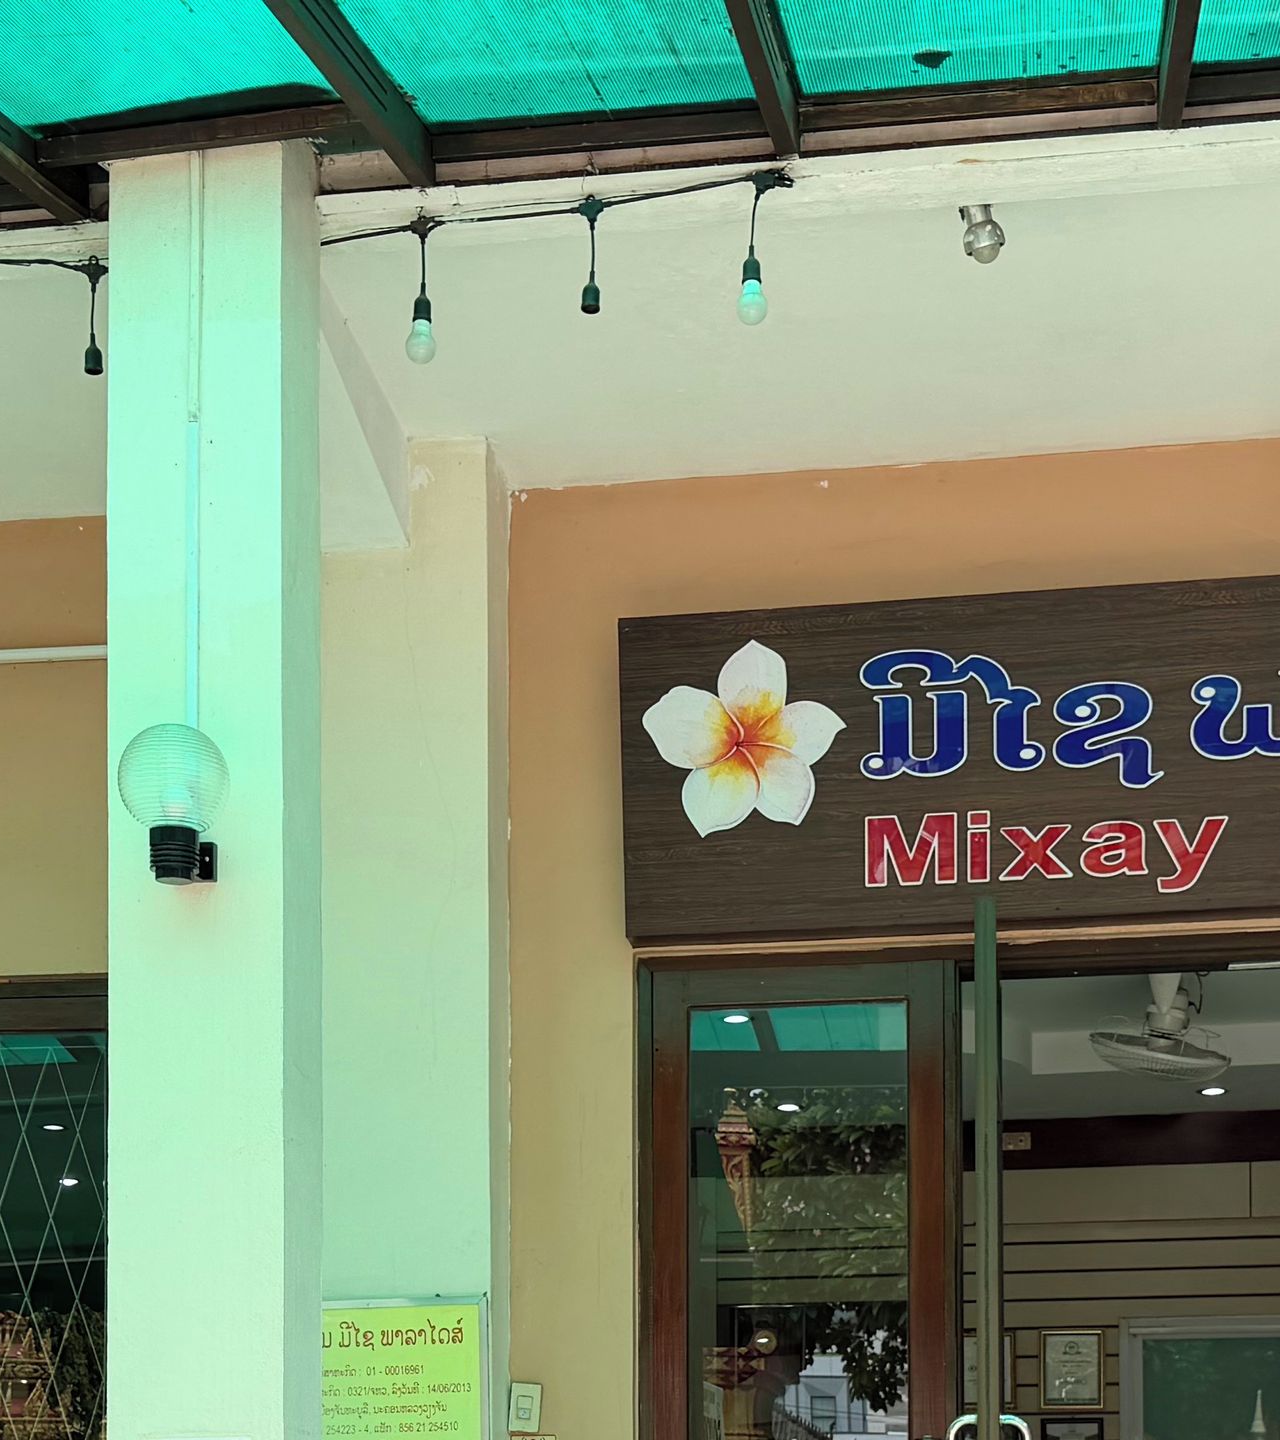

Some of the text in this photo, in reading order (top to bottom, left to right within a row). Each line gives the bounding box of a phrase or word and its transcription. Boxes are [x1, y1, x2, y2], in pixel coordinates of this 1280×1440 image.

[864, 809, 1230, 893] Mixay
[366, 1366, 376, 1376] 01
[427, 1382, 472, 1395] 14/06/2013
[398, 1422, 414, 1433] 856
[416, 1422, 426, 1433] 21
[428, 1420, 459, 1433] 254510
